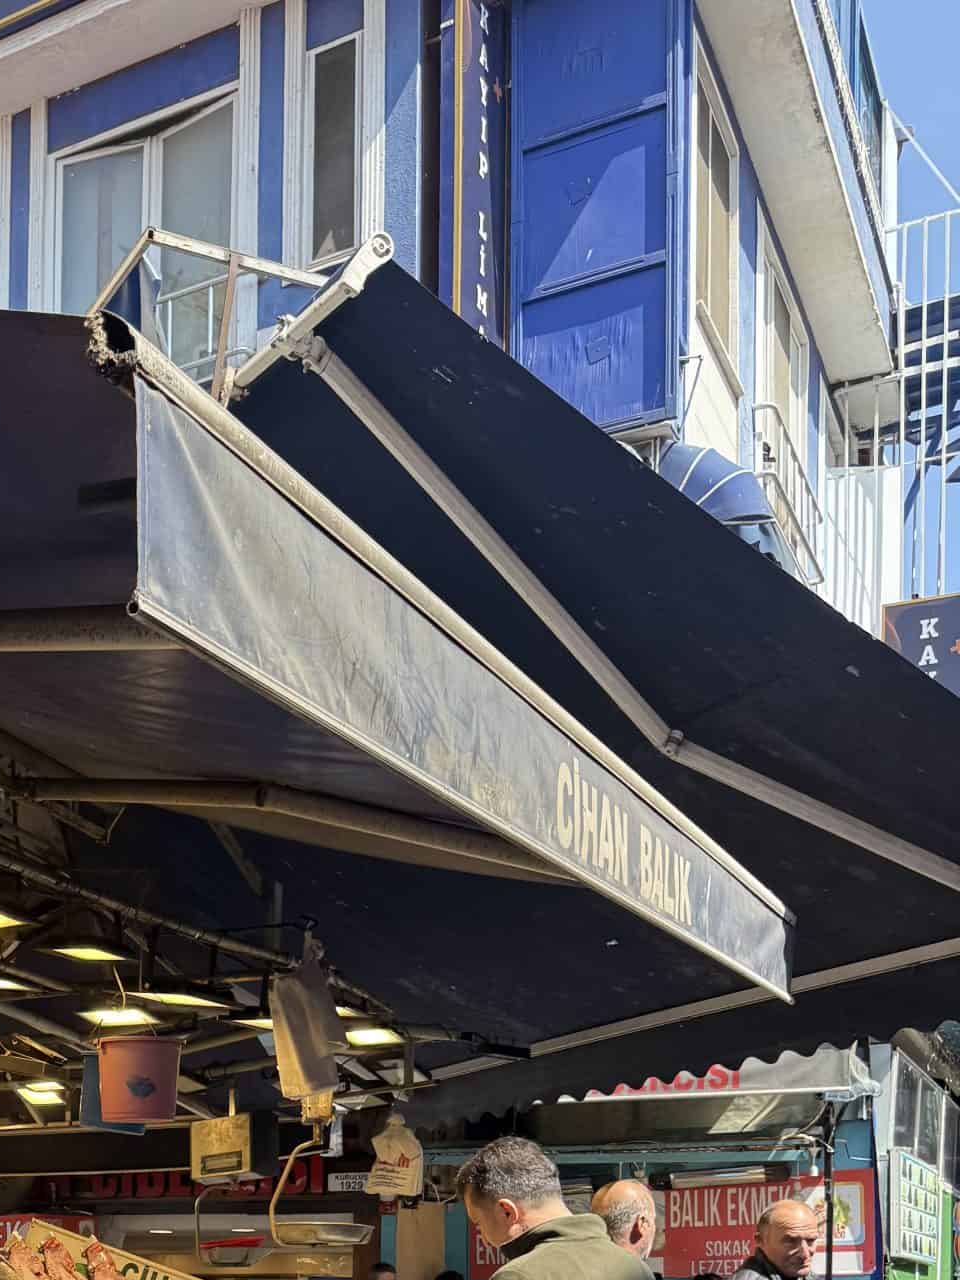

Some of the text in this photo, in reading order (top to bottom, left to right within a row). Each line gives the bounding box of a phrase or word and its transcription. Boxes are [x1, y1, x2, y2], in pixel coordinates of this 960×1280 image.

[556, 757, 692, 926] CİHAN BALIK
[669, 1188, 723, 1228] BALIK
[705, 1239, 751, 1257] SOKAK
